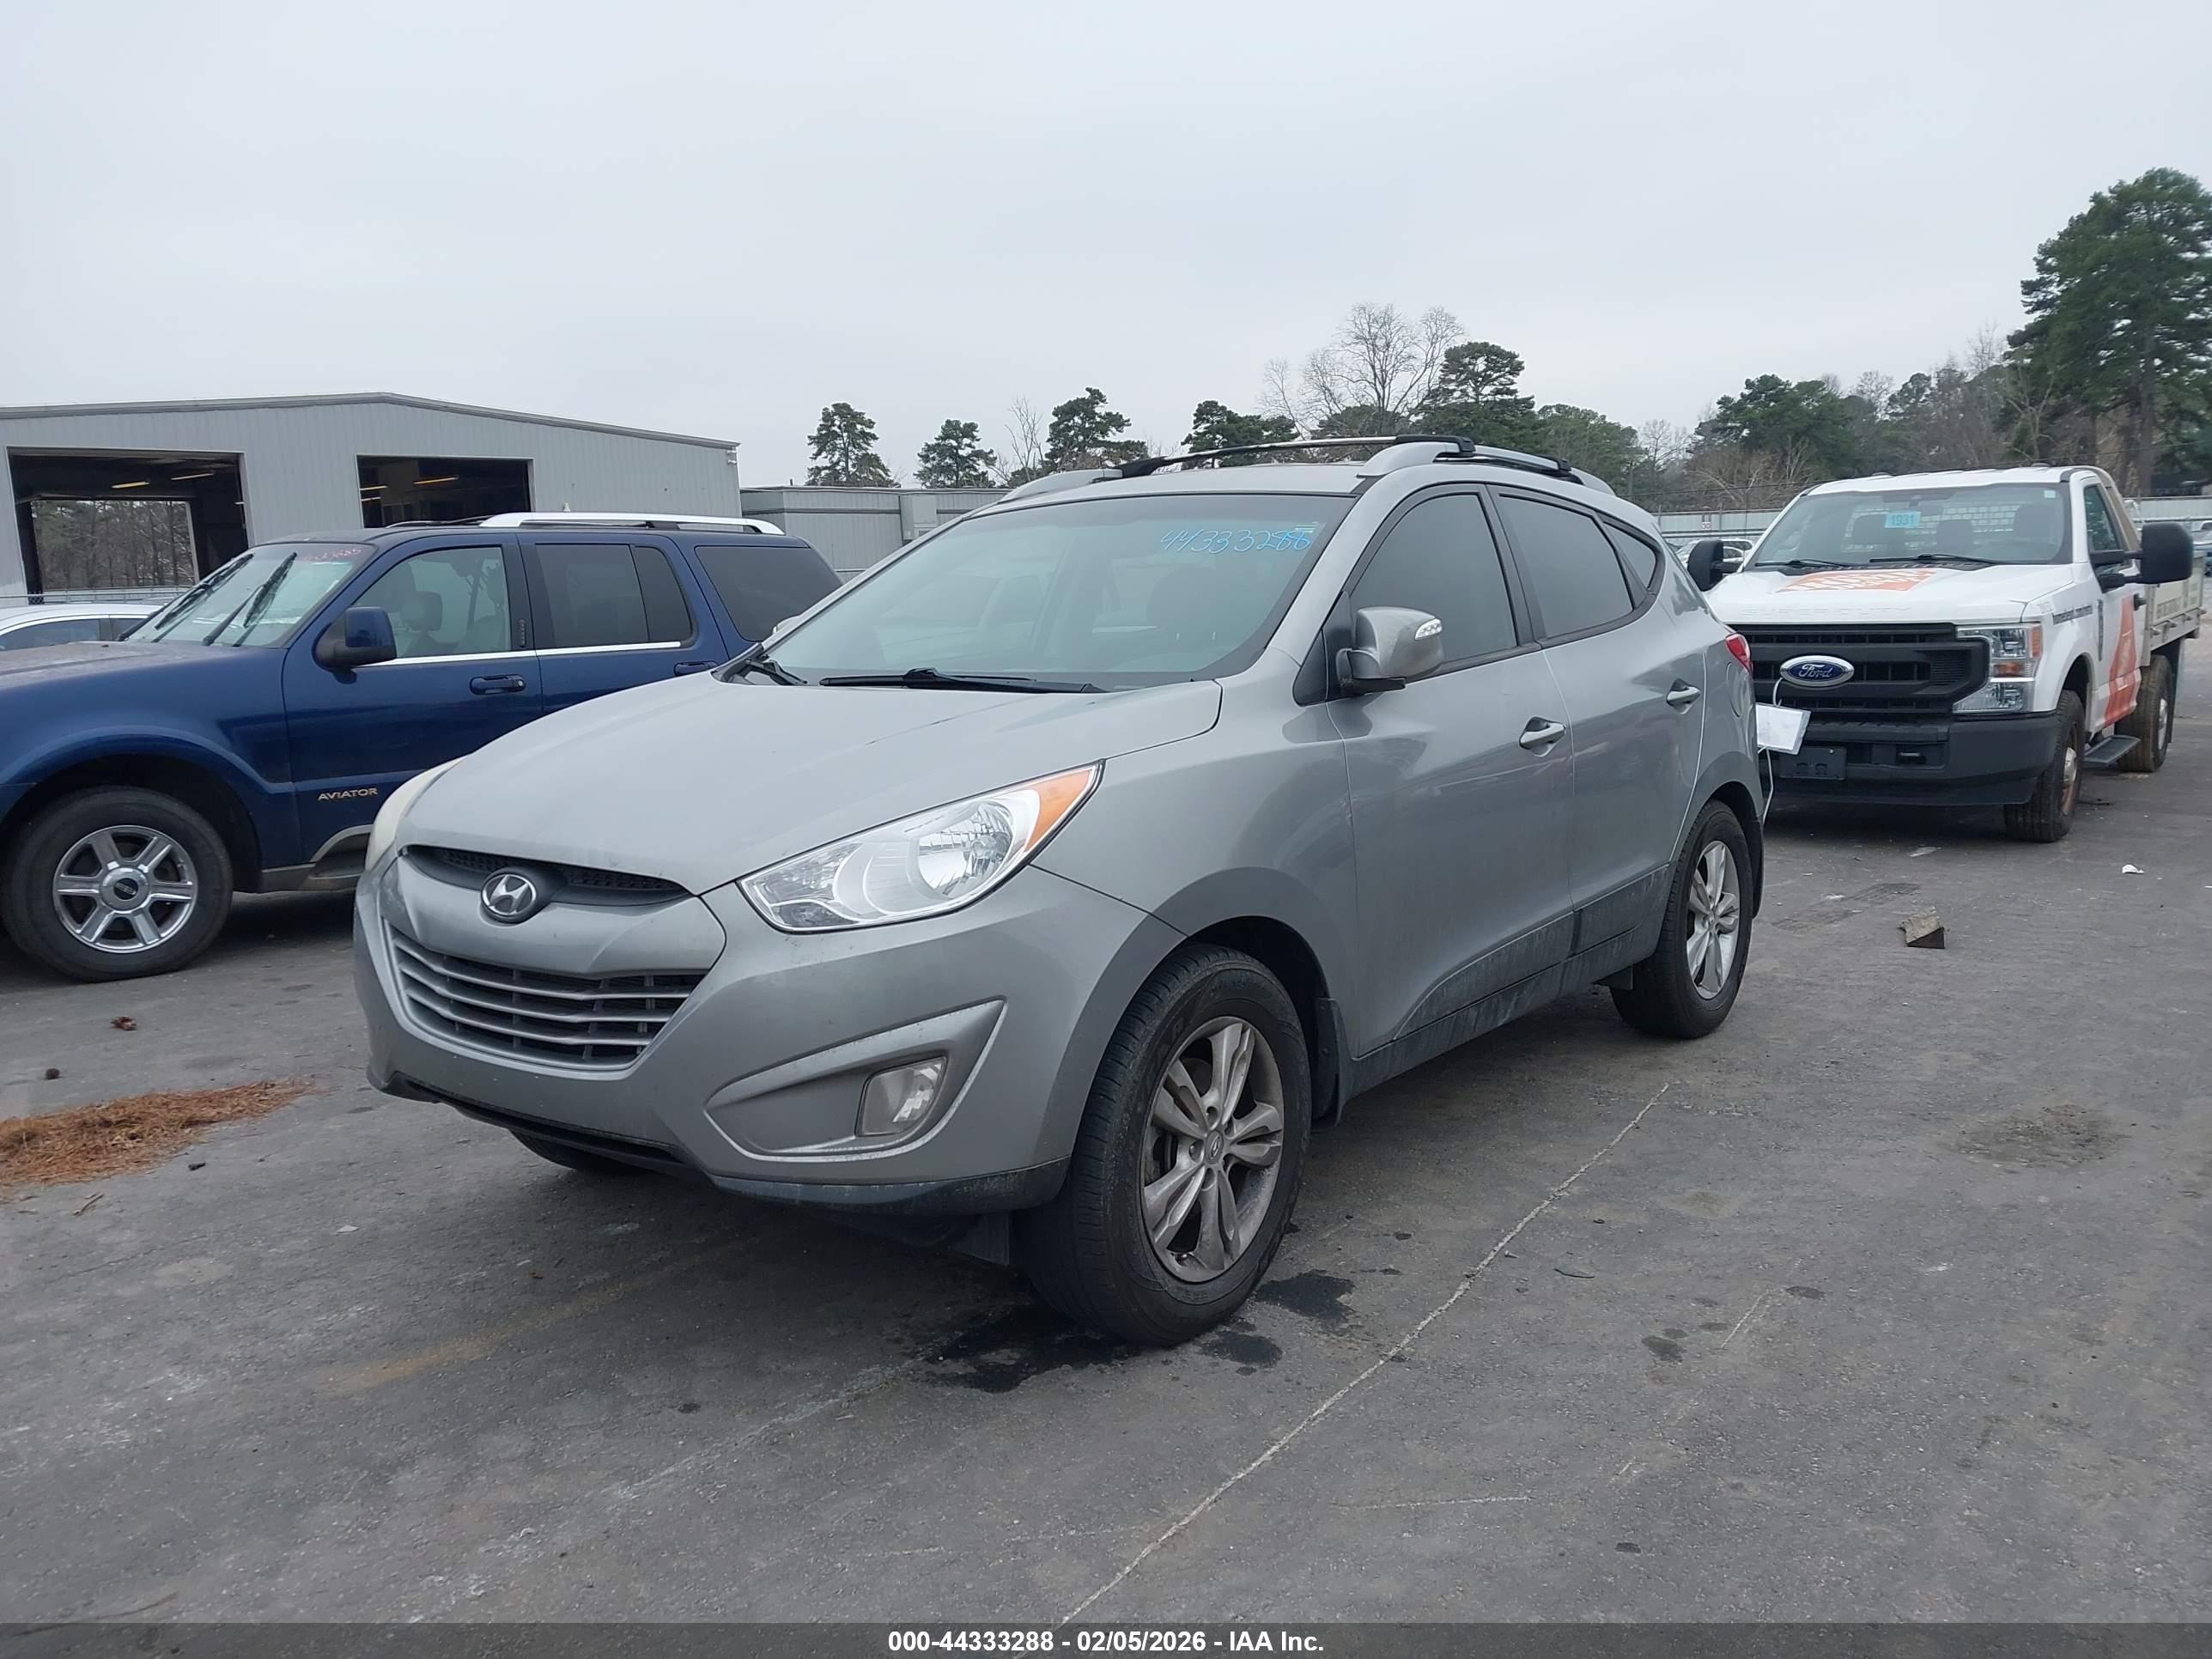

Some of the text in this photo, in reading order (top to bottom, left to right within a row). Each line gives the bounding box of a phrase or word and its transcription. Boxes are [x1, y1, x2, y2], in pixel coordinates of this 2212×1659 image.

[1888, 514, 1916, 526] 1931
[1160, 528, 1311, 554] 44333288
[1798, 663, 1833, 678] Ford
[318, 788, 378, 801] AVIATOR
